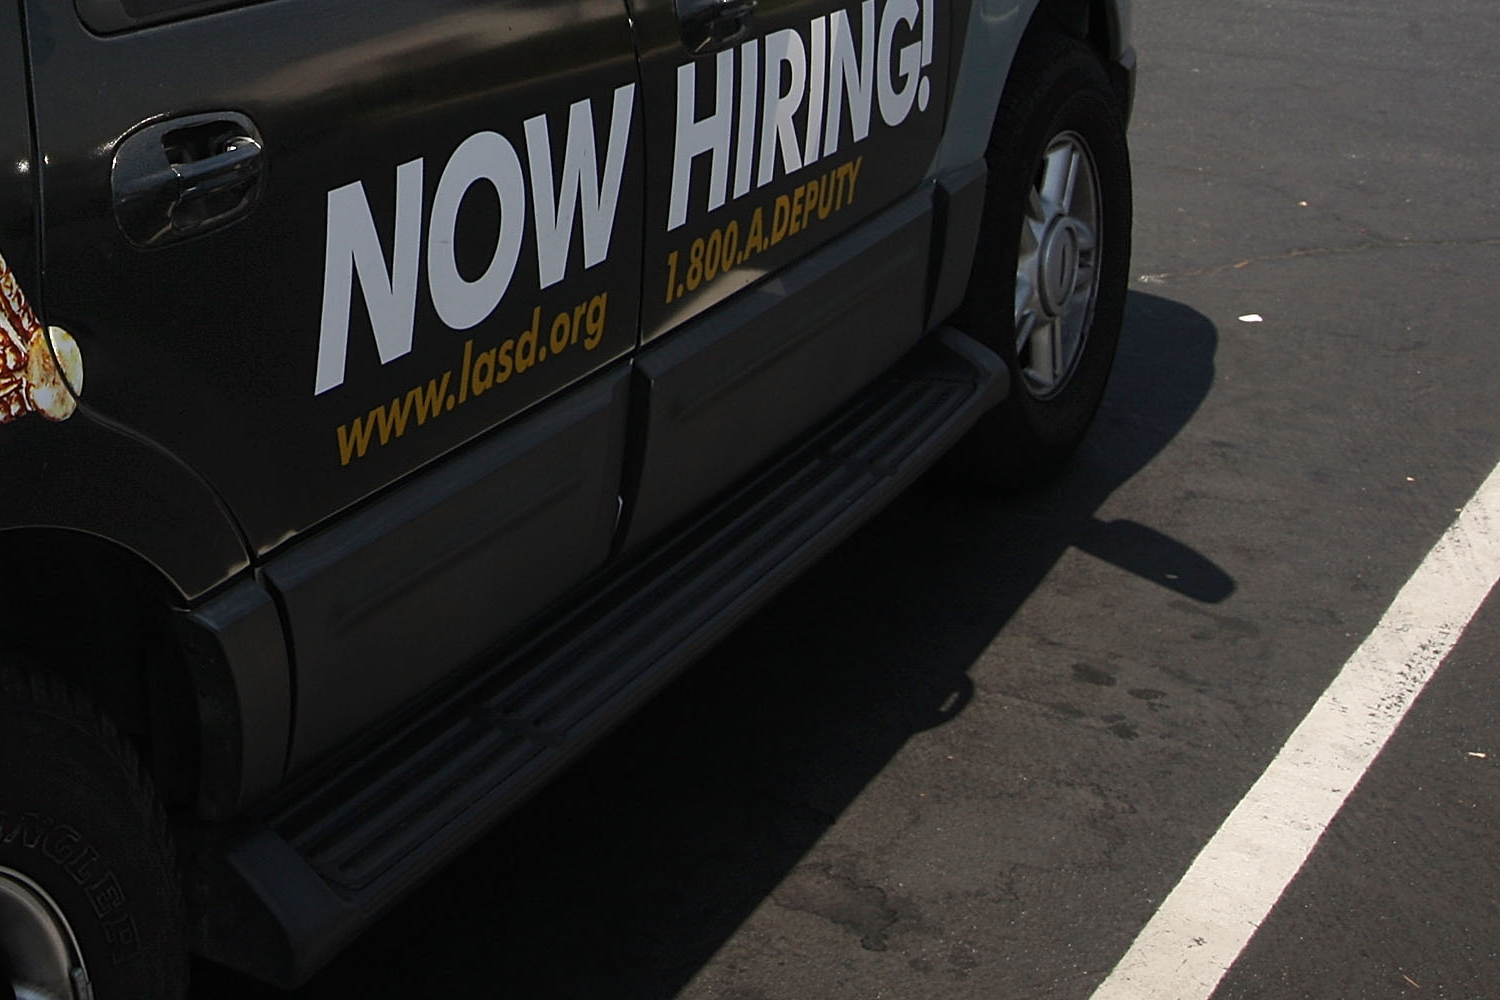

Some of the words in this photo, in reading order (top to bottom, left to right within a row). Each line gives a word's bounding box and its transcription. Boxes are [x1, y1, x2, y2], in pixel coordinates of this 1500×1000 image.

[314, 82, 636, 396] NOW
[664, 155, 864, 304] 1.800.A.DEPUTY
[335, 292, 608, 467] www.lasd.org
